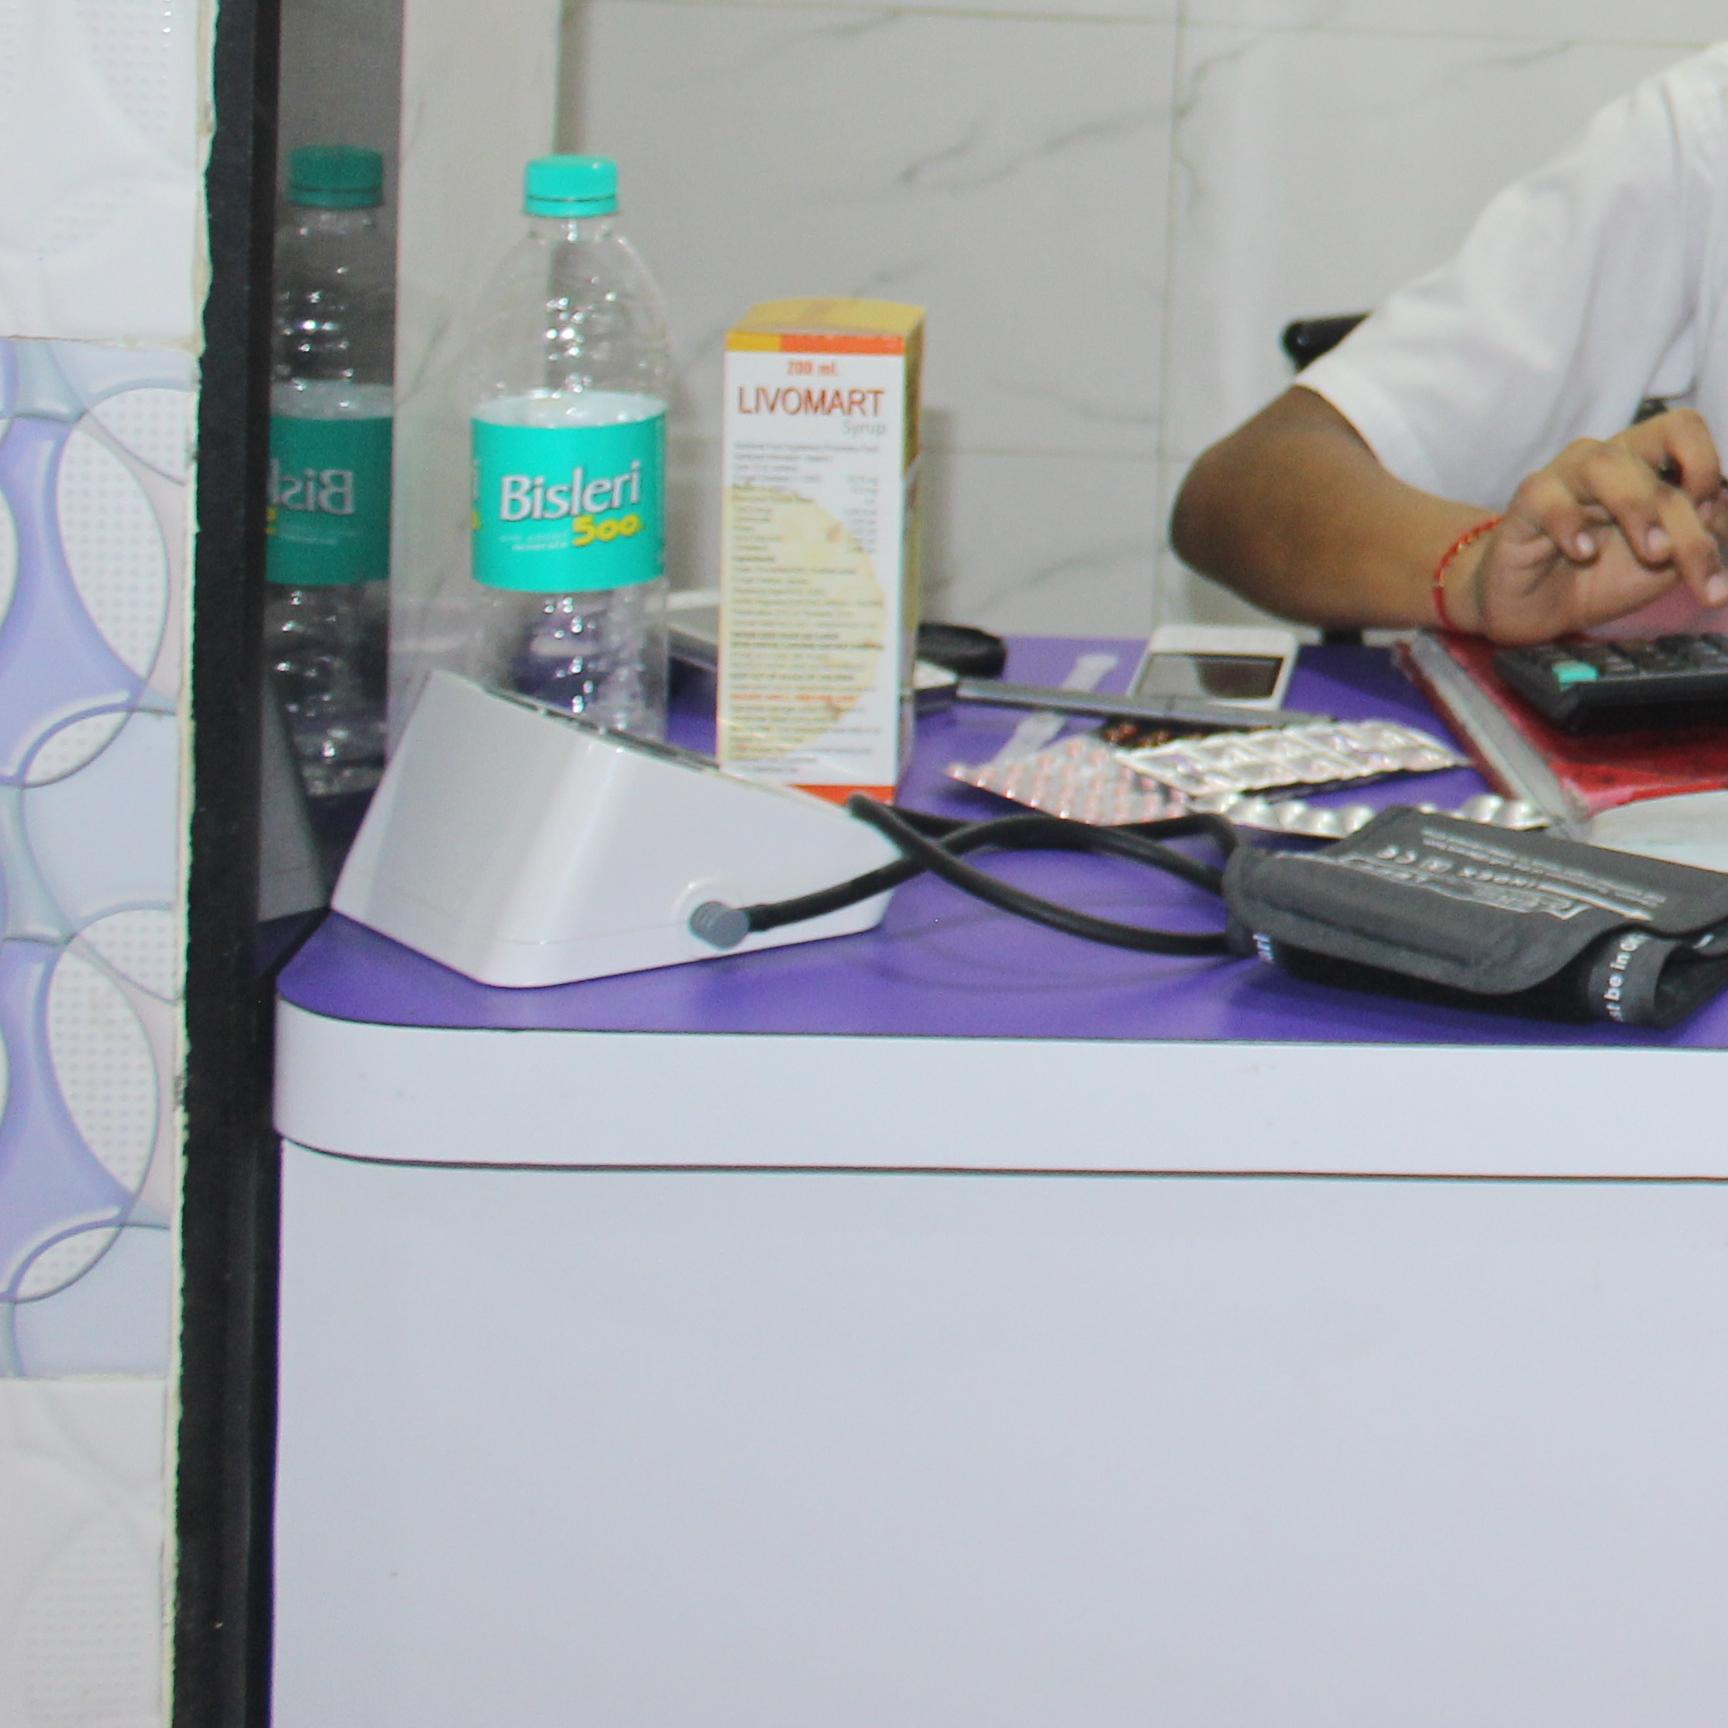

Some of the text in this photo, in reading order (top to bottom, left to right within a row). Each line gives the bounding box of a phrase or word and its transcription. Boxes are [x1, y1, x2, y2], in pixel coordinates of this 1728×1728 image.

[738, 386, 885, 416] LIVOMART
[501, 459, 641, 521] Bisleri
[571, 514, 642, 548] 500
